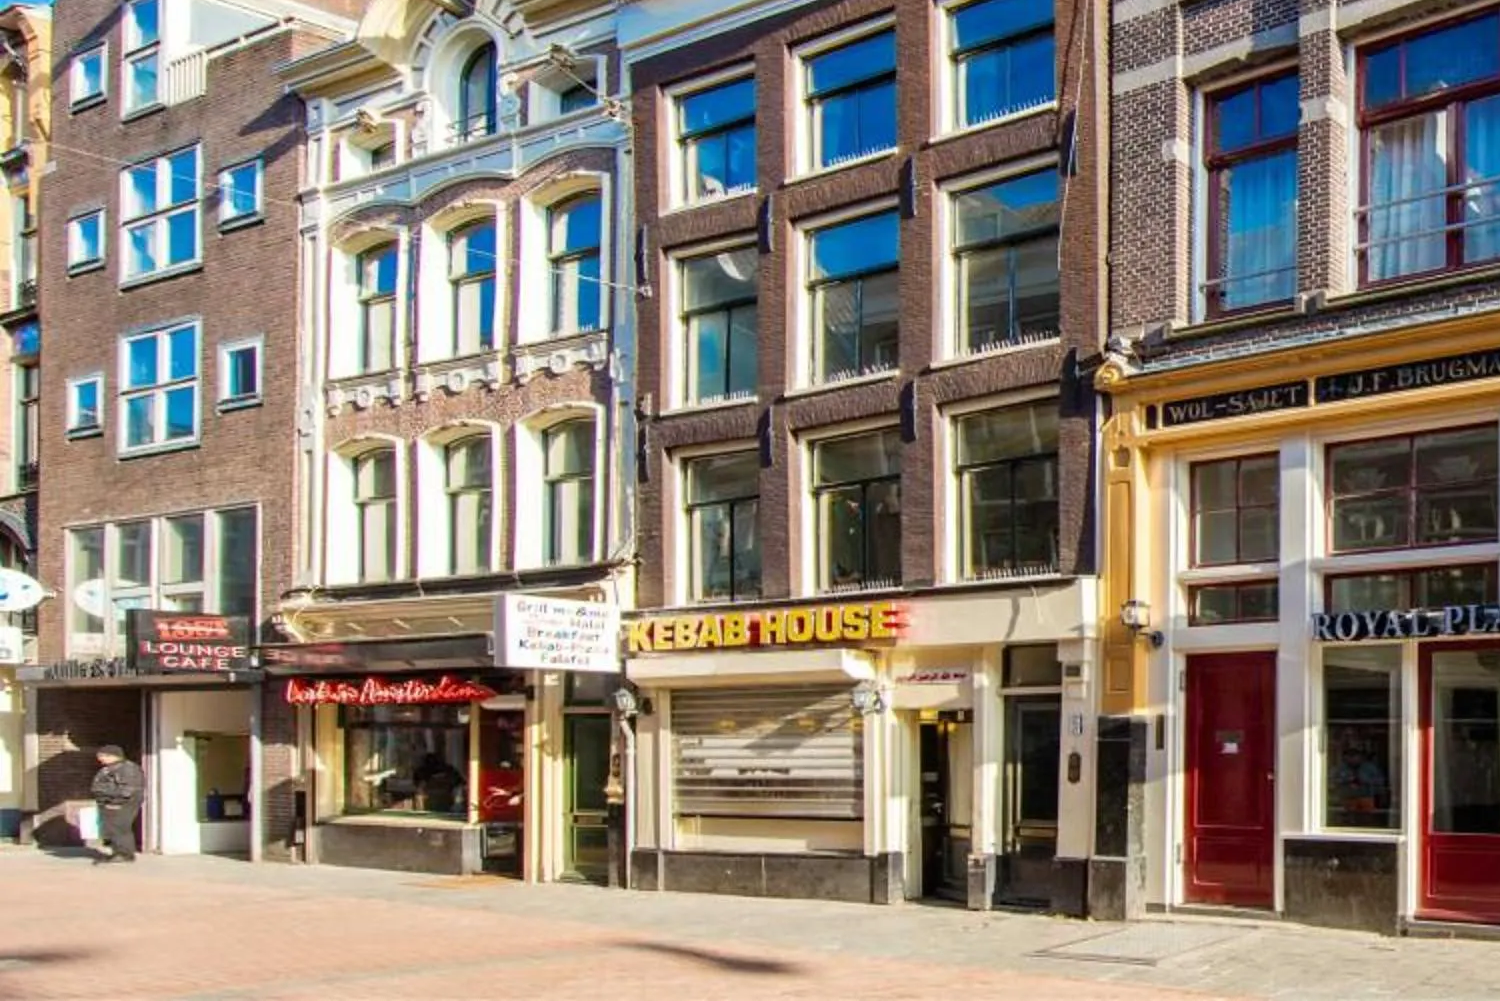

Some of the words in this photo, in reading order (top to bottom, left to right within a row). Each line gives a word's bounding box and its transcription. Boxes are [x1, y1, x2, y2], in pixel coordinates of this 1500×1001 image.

[628, 611, 749, 652] KEBAB
[759, 601, 893, 645] HOUSE
[1312, 608, 1430, 641] ROYAL
[146, 640, 247, 659] LOUNGE
